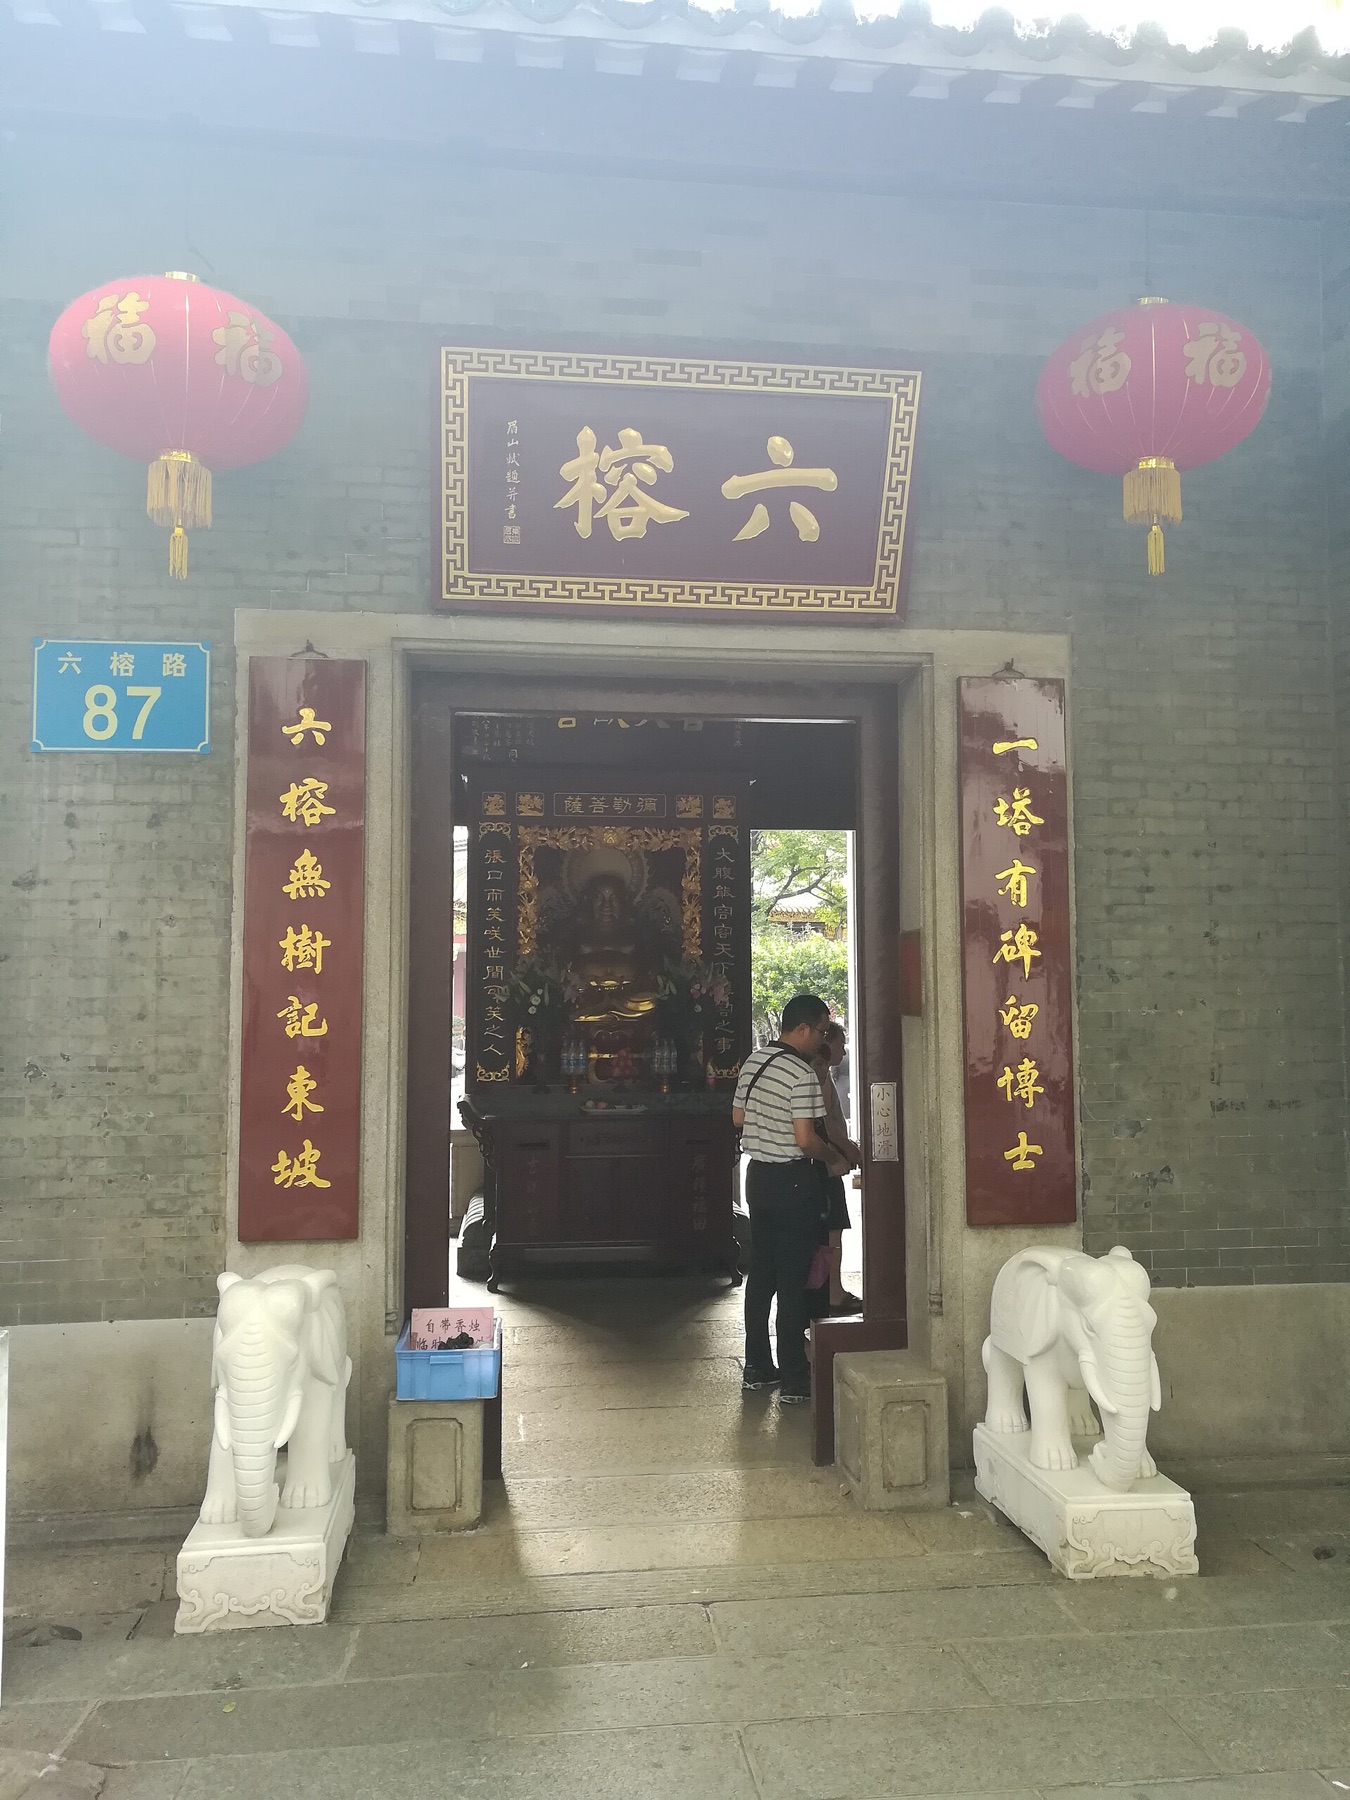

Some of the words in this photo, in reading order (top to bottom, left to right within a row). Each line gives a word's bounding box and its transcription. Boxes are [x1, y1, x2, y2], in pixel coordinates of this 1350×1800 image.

[81, 291, 157, 365] 福
[211, 310, 283, 387] 福
[1069, 326, 1132, 398] 福
[1183, 322, 1247, 388] 福
[553, 425, 839, 543] 六榕
[56, 650, 188, 679] 六榕路
[82, 684, 162, 742] 87
[564, 795, 658, 814] 彌勒菩薩
[270, 707, 337, 1191] 六榕無樹記東坡
[876, 1087, 893, 1156] 小心地滑
